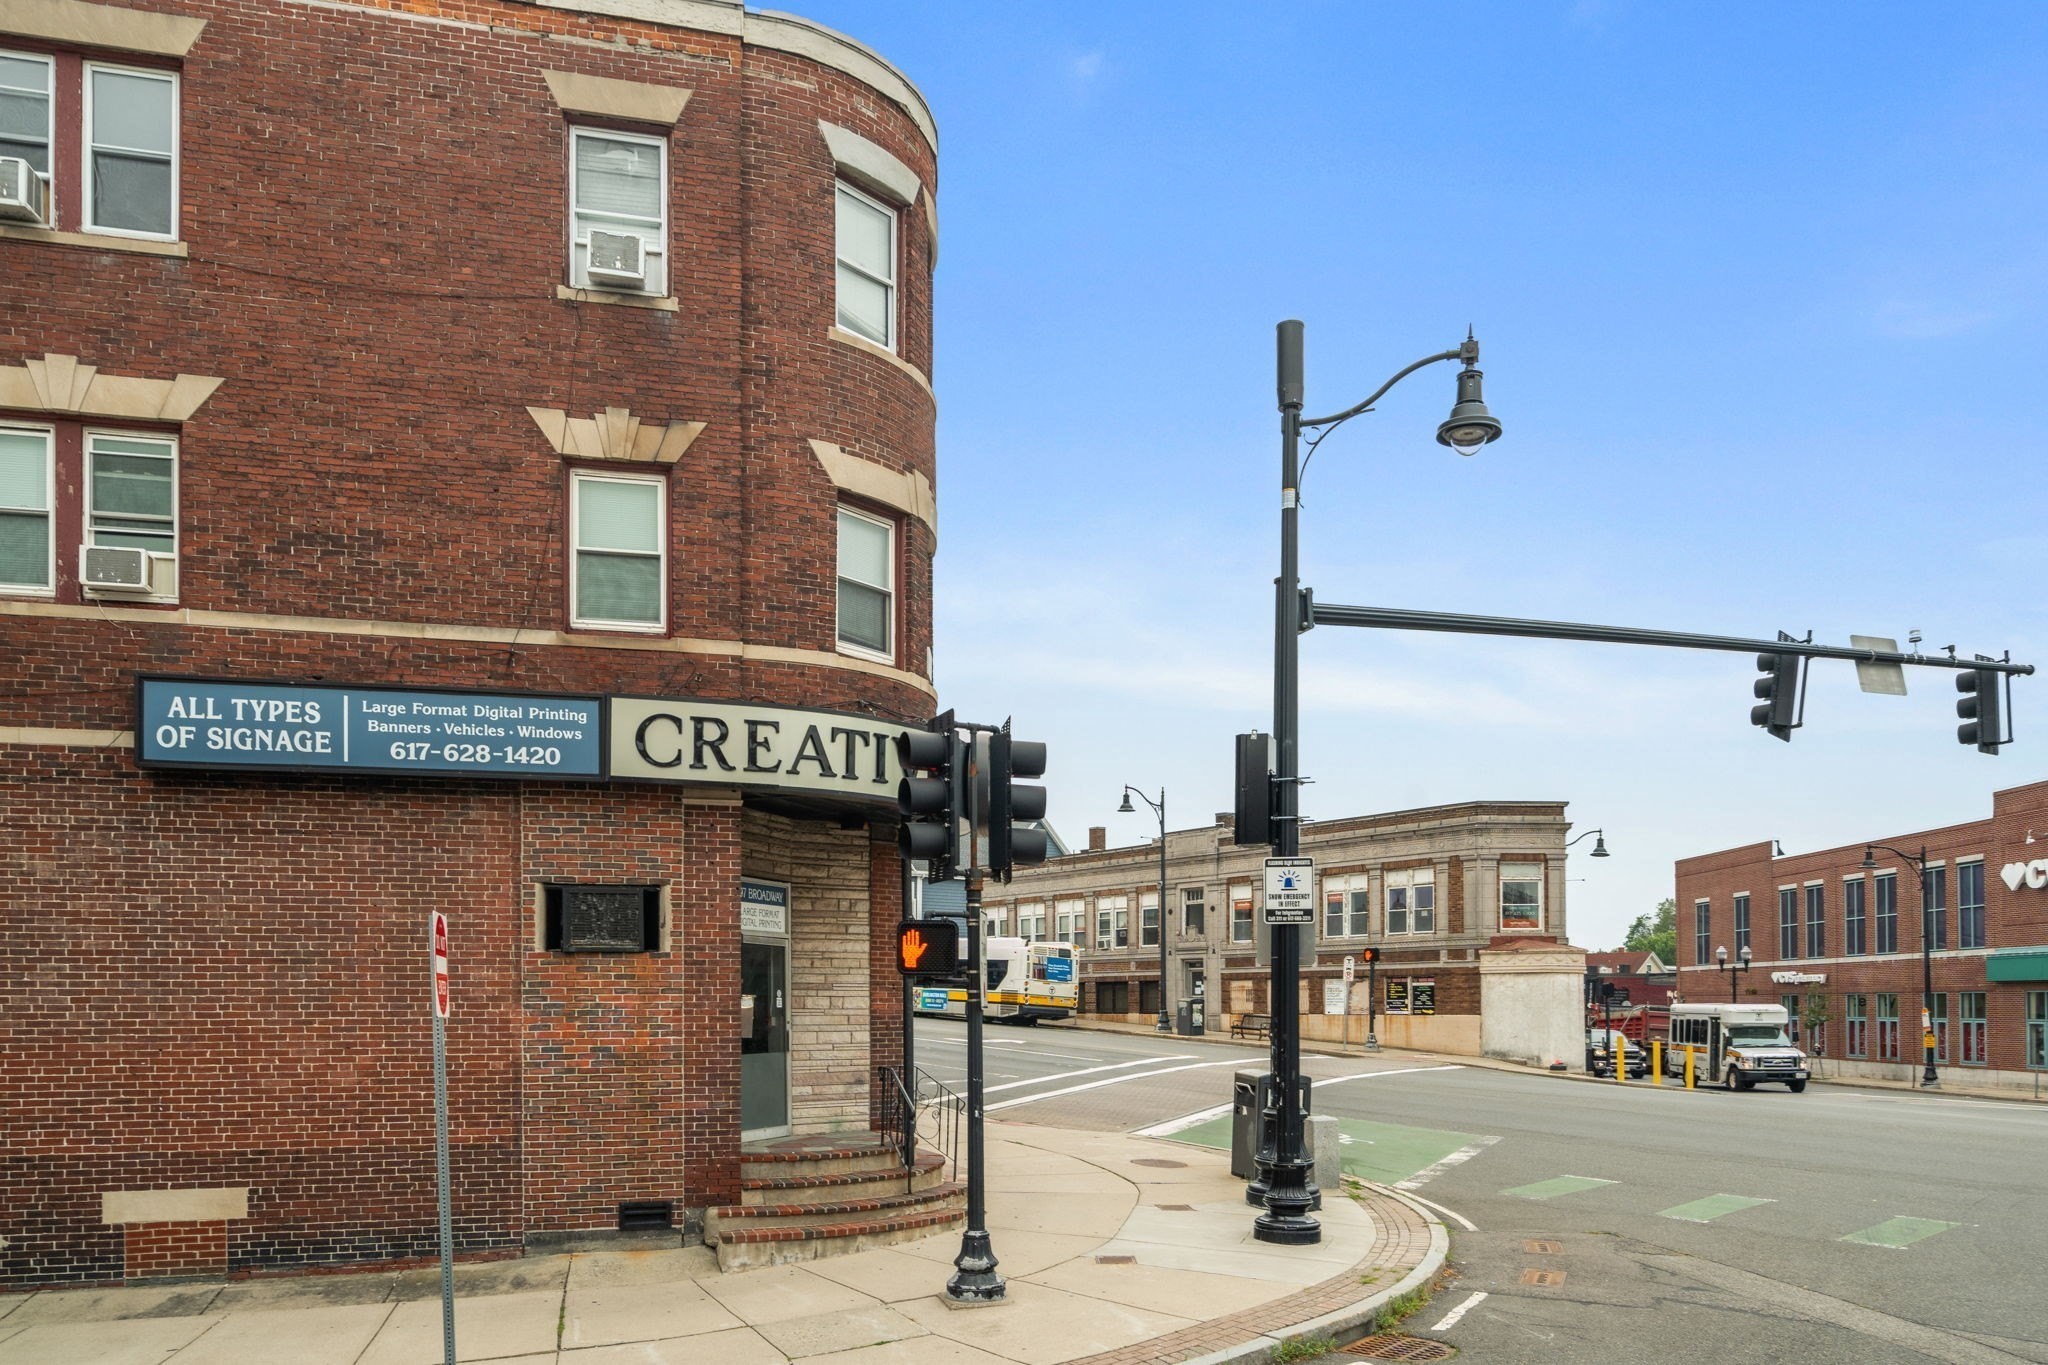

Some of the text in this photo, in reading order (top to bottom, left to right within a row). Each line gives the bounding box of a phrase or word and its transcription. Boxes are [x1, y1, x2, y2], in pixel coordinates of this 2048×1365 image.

[168, 696, 321, 724] ALL TYPES
[362, 700, 588, 724] Large Format Digital Printing
[156, 725, 332, 753] OF SIGNAGE
[368, 720, 583, 740] Banners Vehicles Windows
[390, 742, 561, 766] 617-628-1420
[748, 887, 784, 903] BROADWAY
[741, 908, 780, 919] ARGE FORMAT
[742, 918, 757, 928] GITAL
